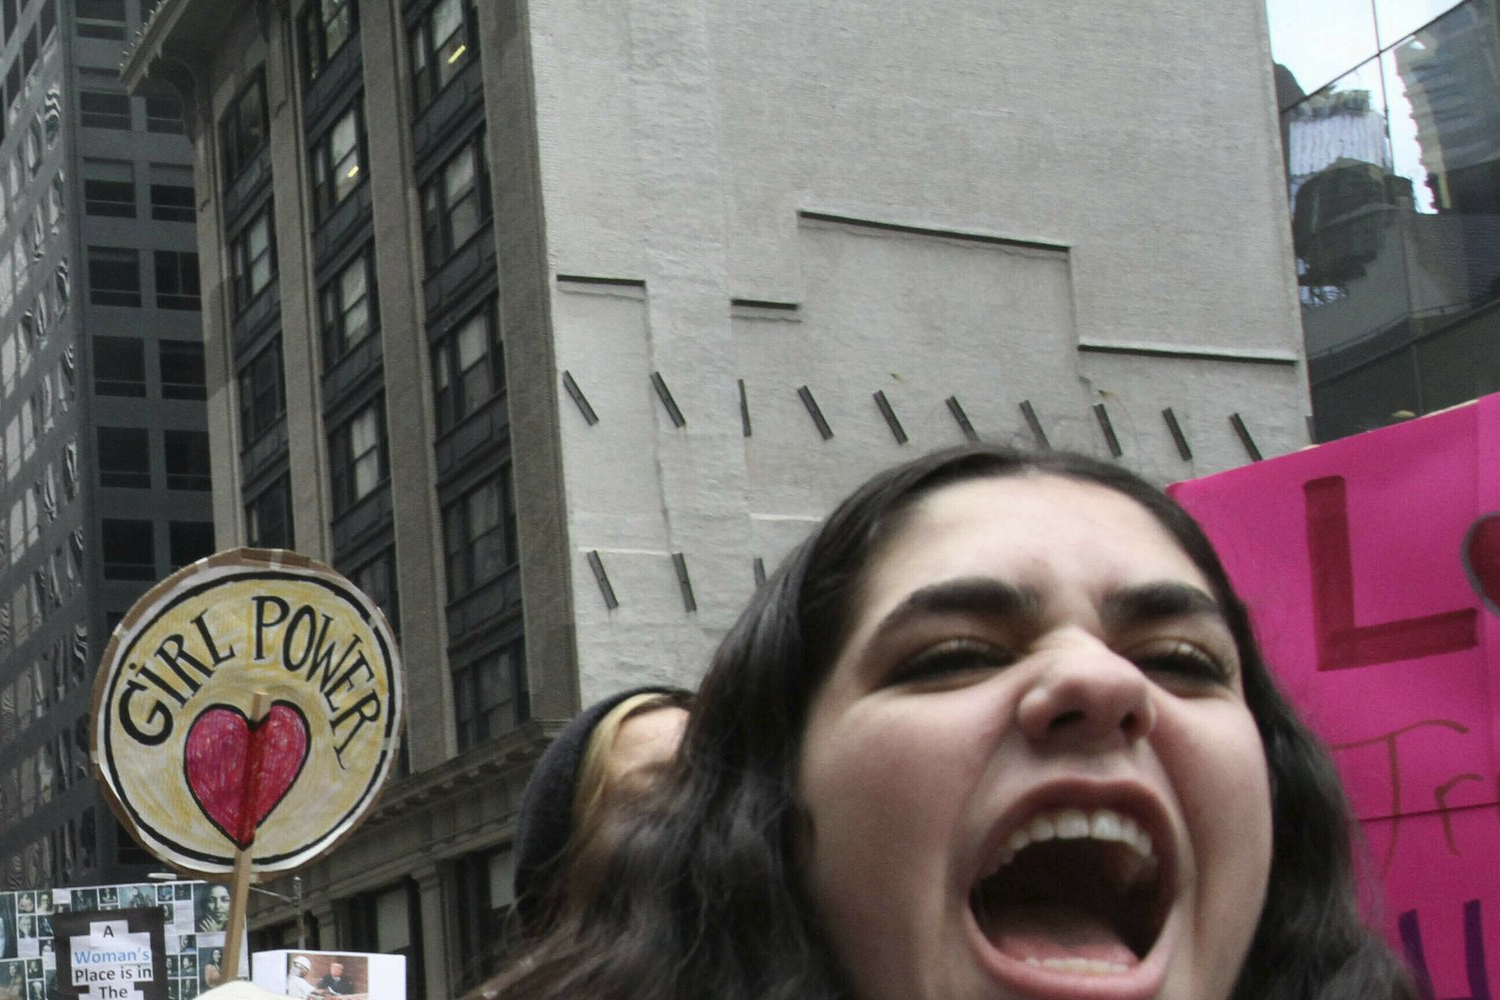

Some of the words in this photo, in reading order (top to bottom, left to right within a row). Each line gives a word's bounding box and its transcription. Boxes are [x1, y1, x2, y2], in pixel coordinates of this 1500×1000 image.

[251, 595, 382, 771] POWER
[103, 925, 114, 938] A
[74, 947, 150, 965] Woman's
[75, 967, 115, 983] Place
[120, 965, 133, 979] is
[137, 965, 152, 979] in
[98, 985, 128, 1000] The
